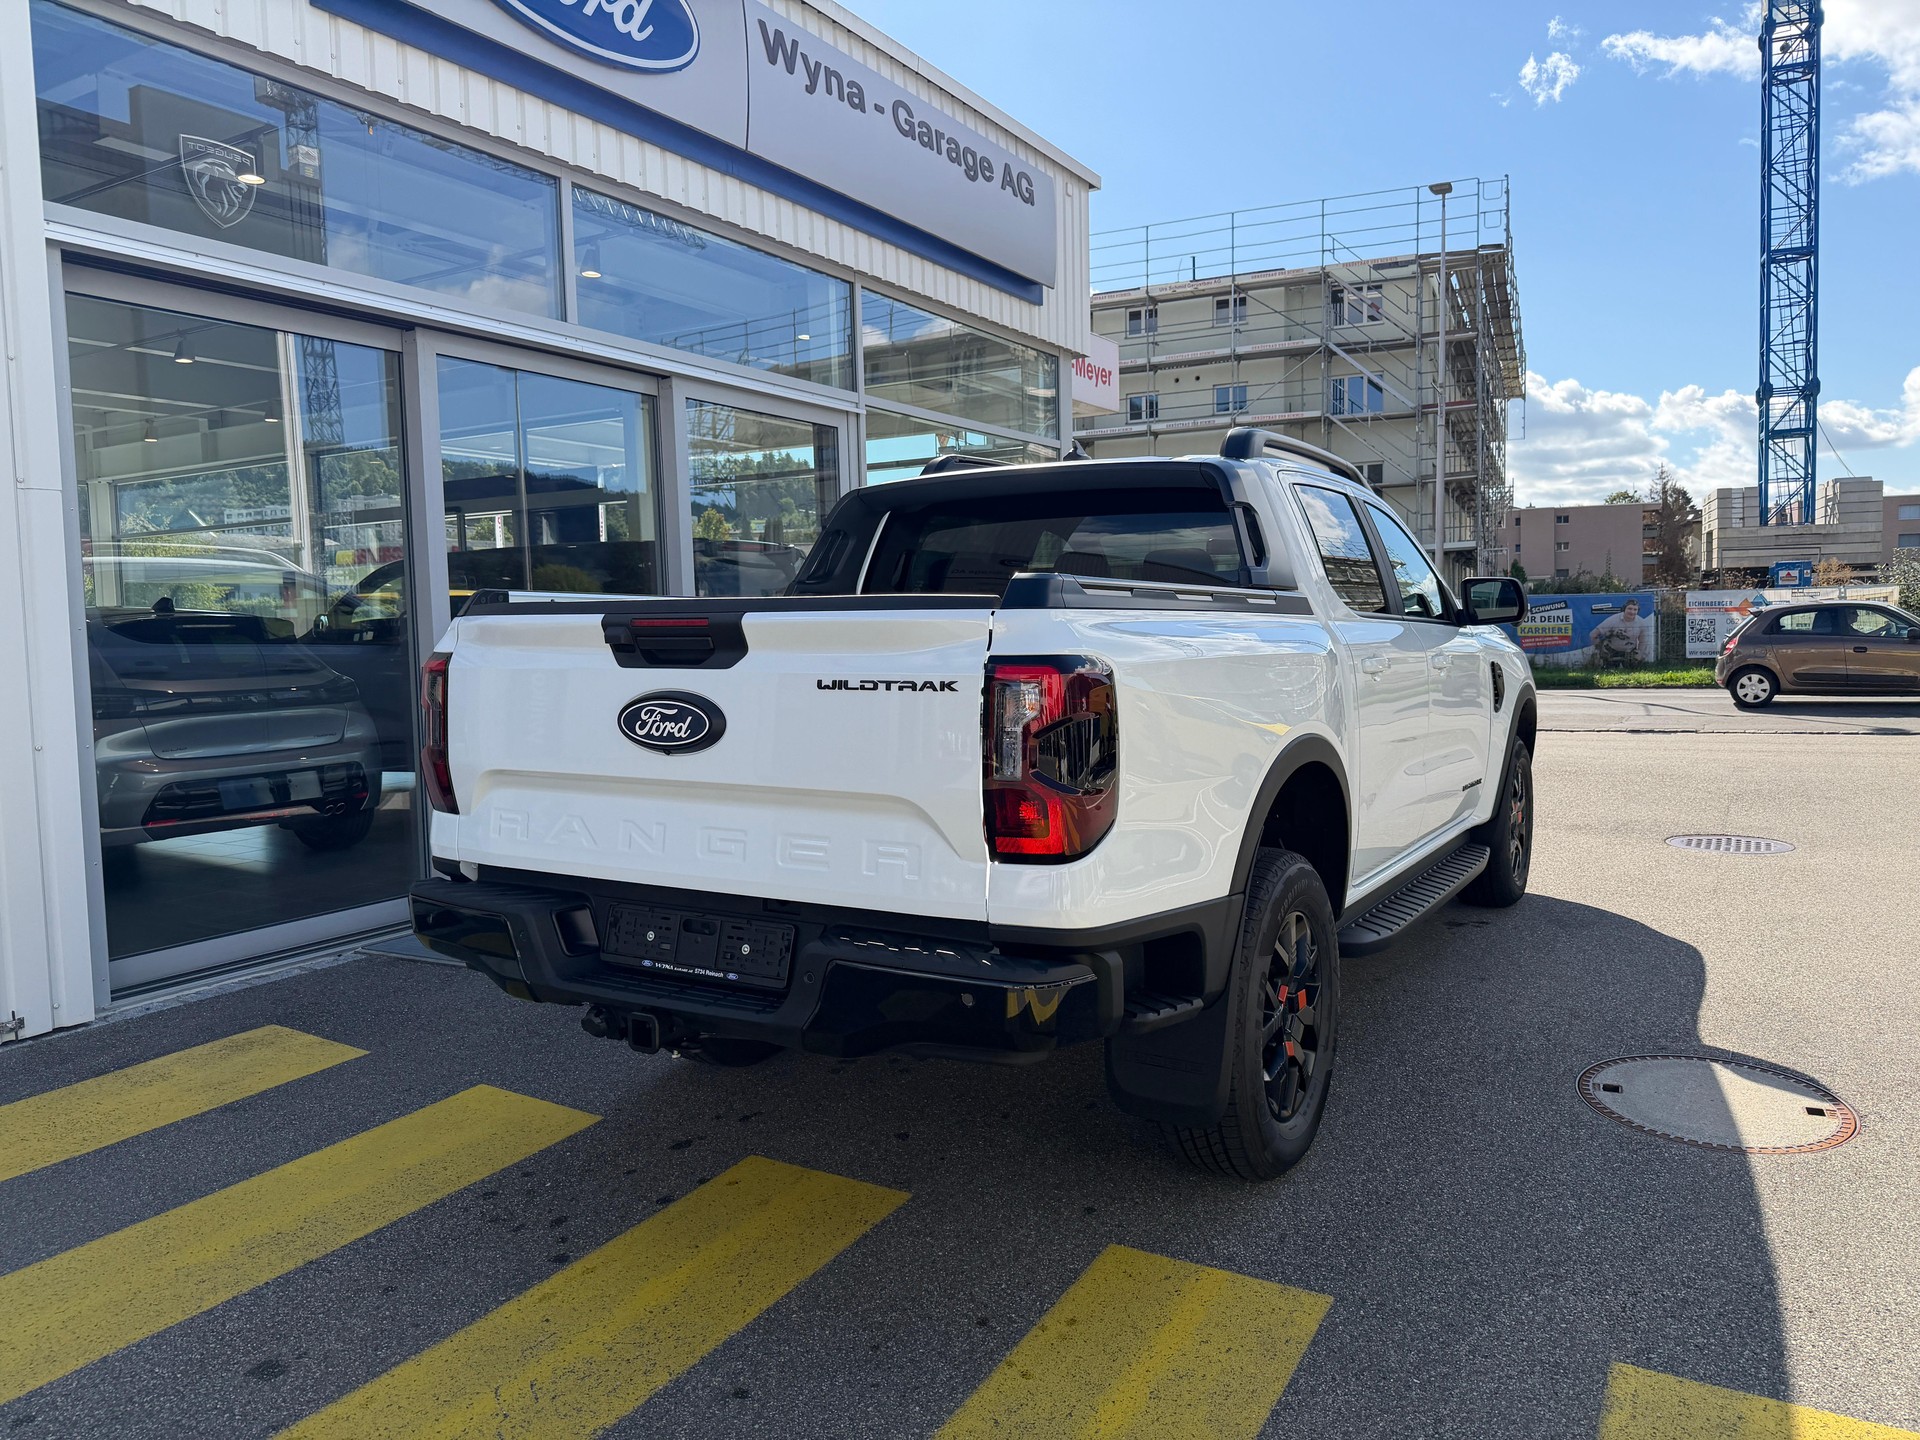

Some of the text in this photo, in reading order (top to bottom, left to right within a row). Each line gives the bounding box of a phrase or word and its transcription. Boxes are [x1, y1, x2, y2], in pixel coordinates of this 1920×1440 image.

[757, 18, 867, 115] Wyna
[893, 99, 995, 183] Garage
[1001, 162, 1036, 206] AG
[1532, 602, 1566, 614] SCHWUNG
[1540, 615, 1570, 623] DEINE
[1520, 626, 1569, 635] KARRIERE
[817, 679, 958, 692] WILDTRAK
[635, 705, 692, 739] Ford
[489, 806, 923, 881] RANGER
